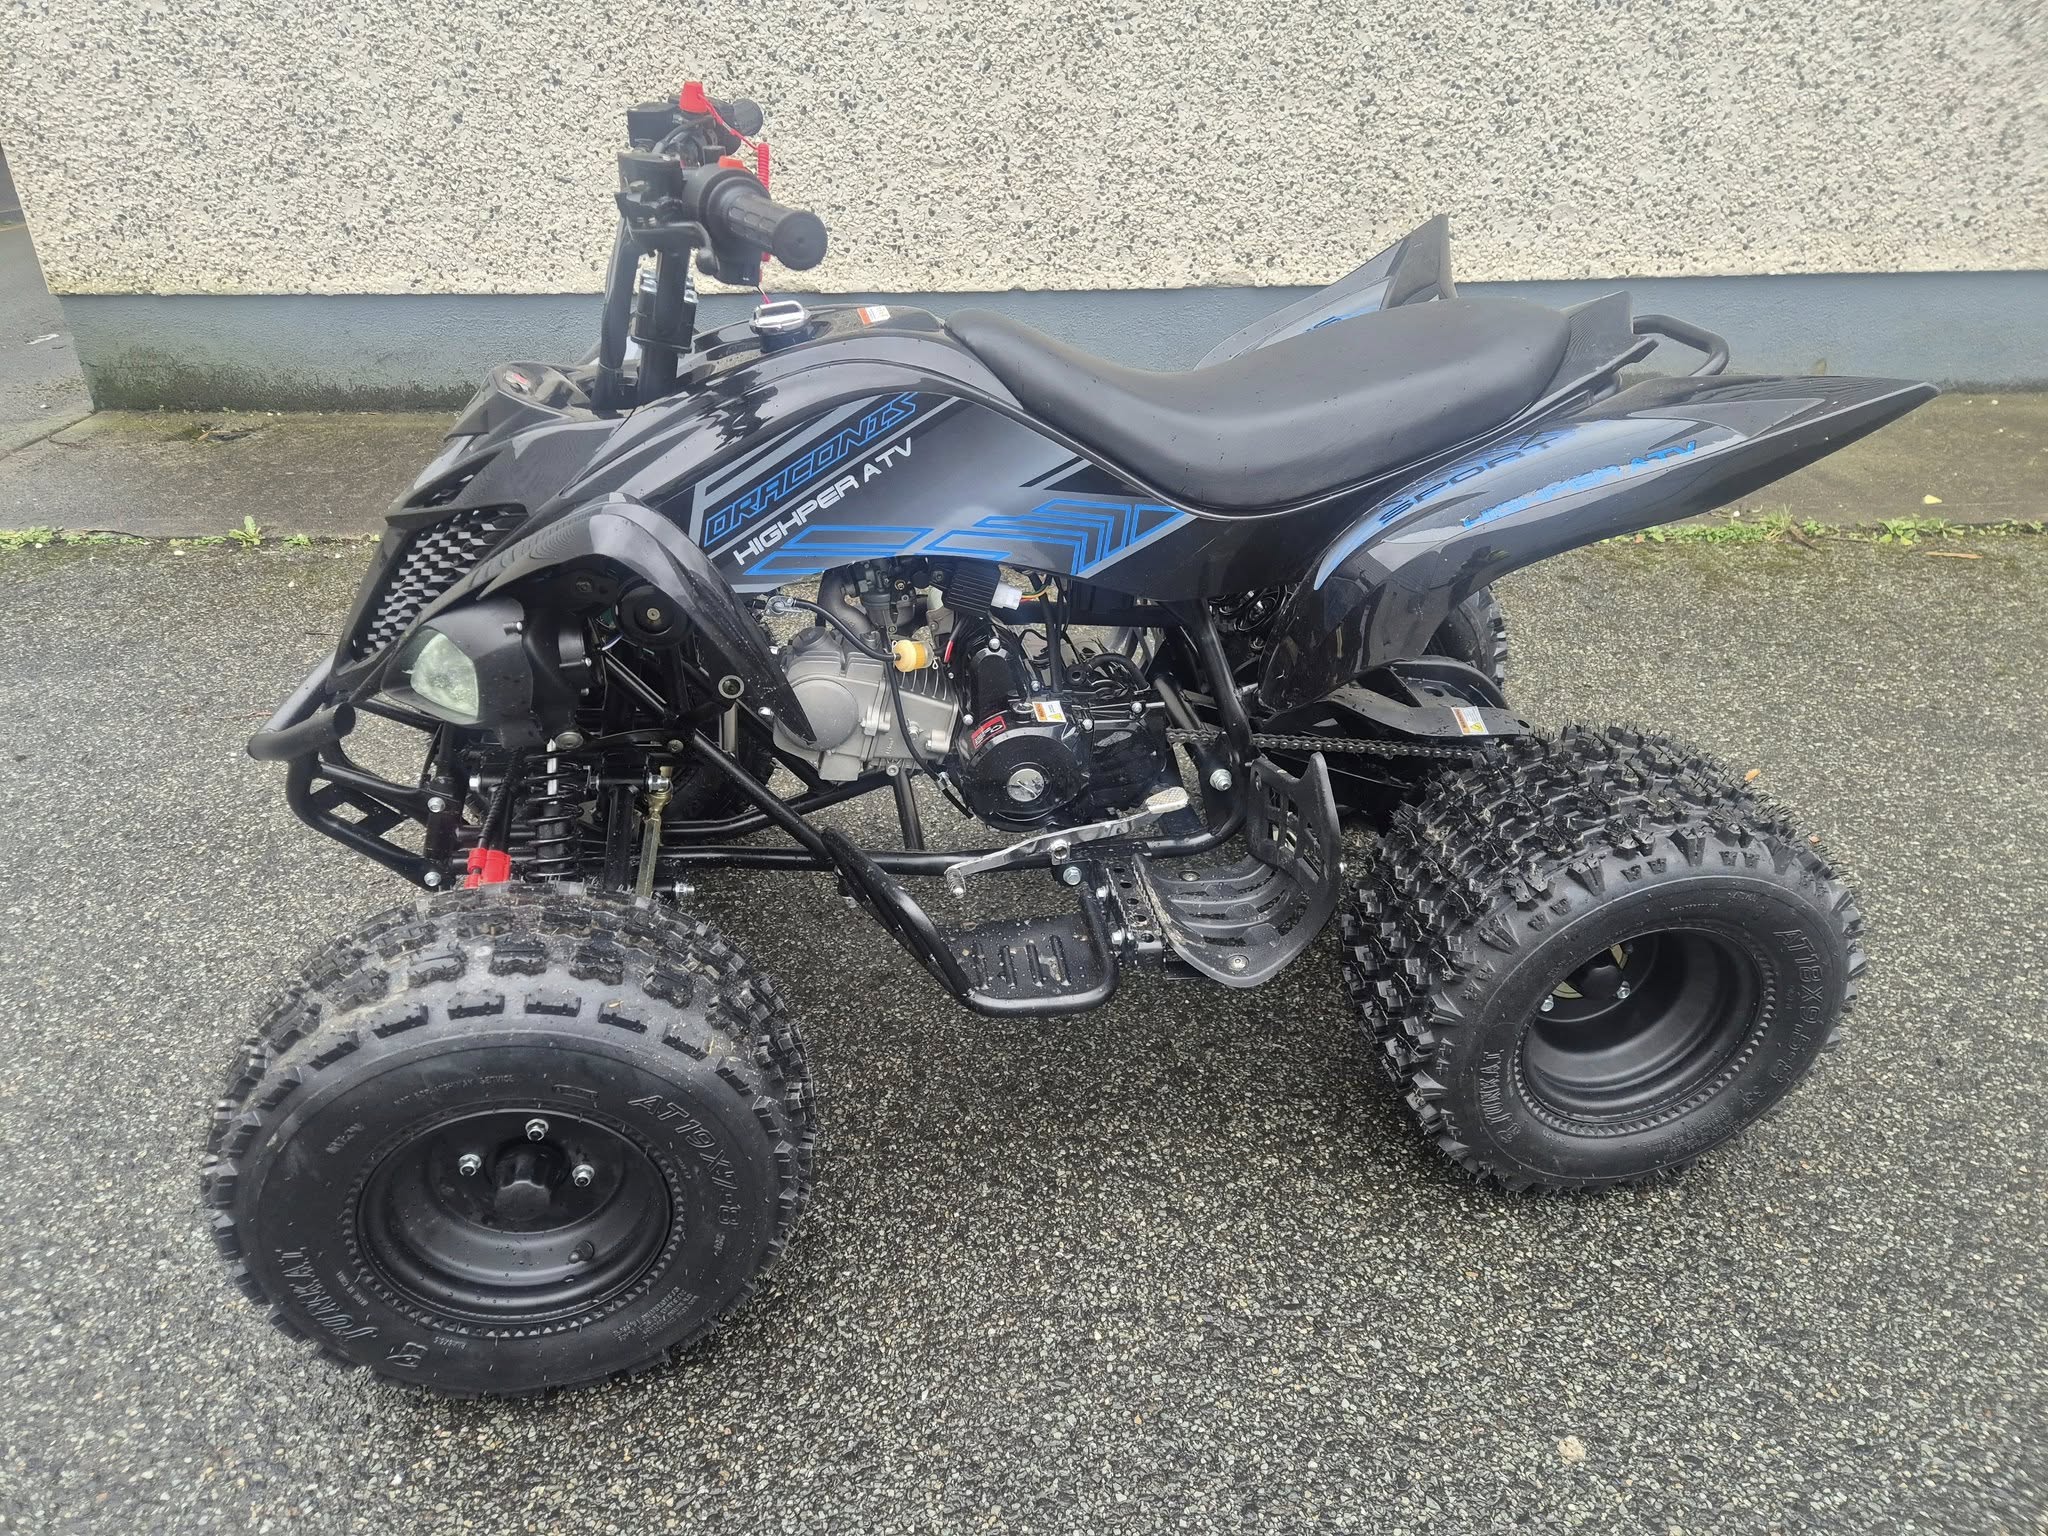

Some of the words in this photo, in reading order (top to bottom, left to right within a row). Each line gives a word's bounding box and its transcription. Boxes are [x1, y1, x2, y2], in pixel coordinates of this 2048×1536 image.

[703, 391, 918, 548] DRACONIS
[732, 473, 860, 566] HIGHPER
[862, 436, 913, 484] ATV
[627, 1094, 742, 1226] AT19X7-8
